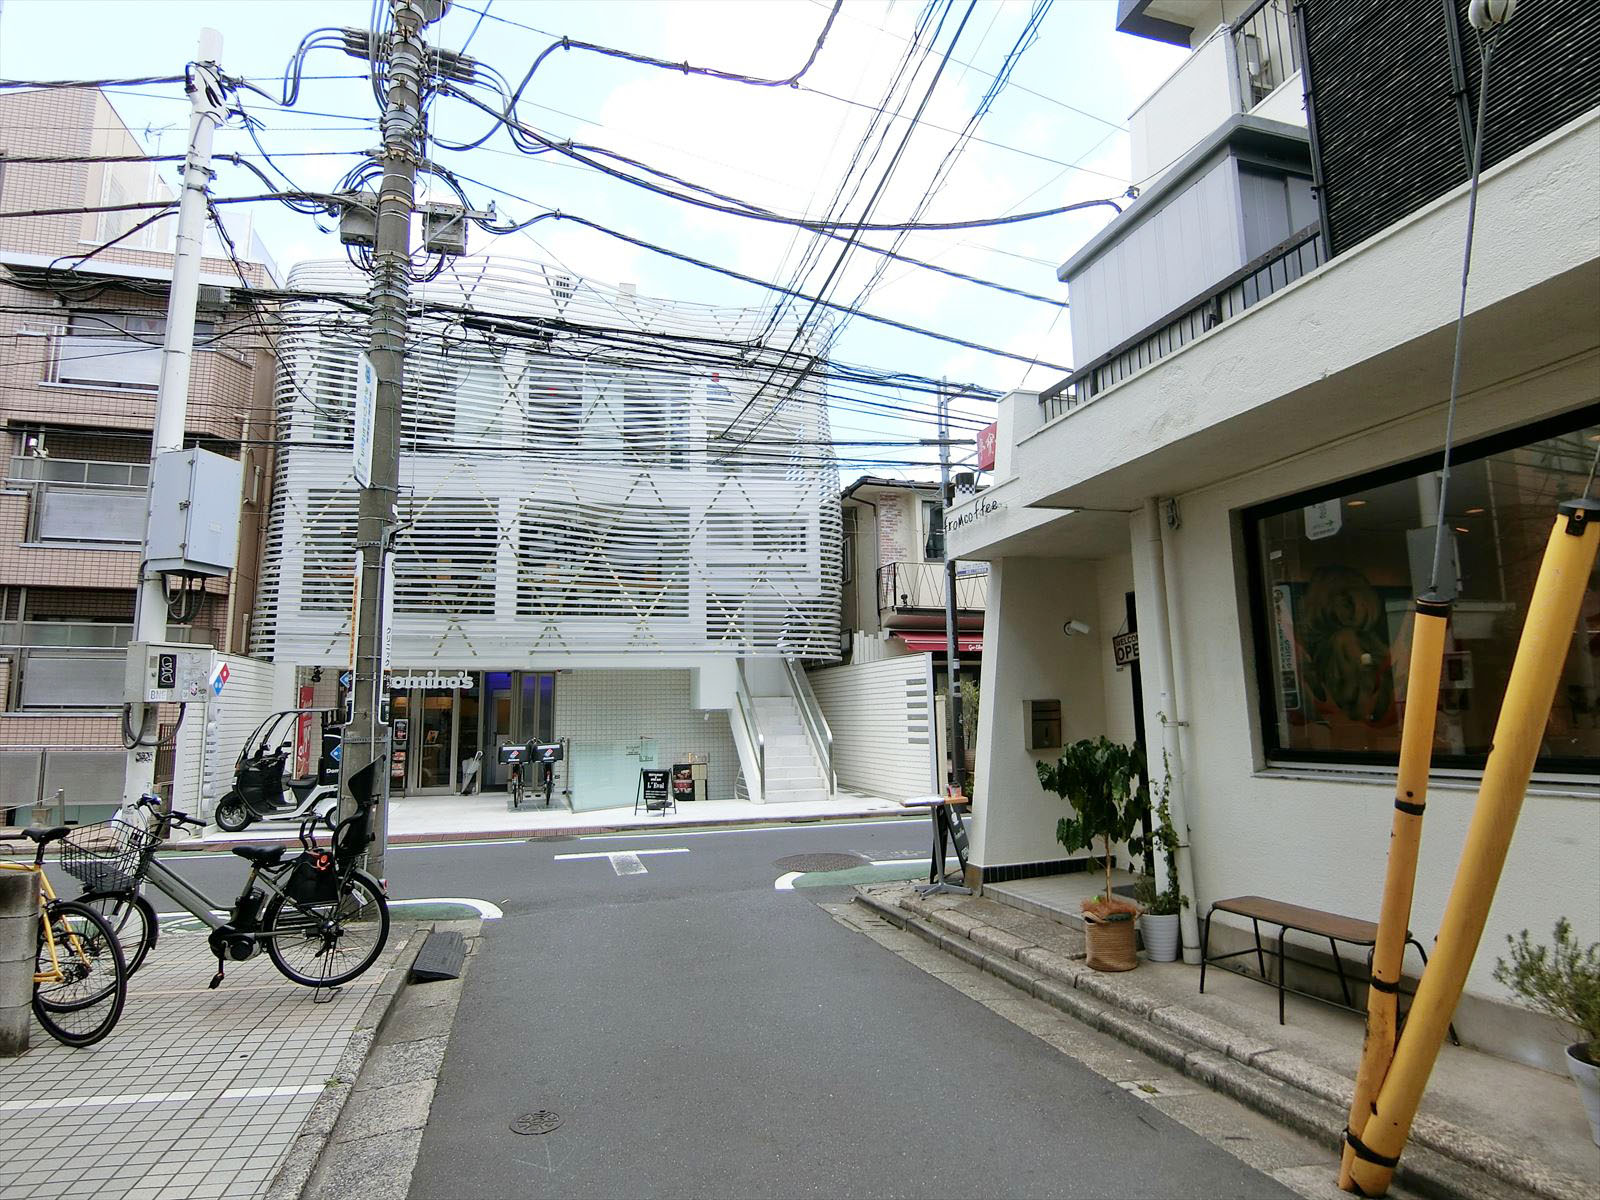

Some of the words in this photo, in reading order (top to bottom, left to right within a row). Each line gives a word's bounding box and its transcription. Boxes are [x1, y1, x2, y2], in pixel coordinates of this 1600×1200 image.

[1115, 634, 1137, 647] WELCO
[1117, 642, 1139, 661] OPE
[391, 671, 474, 689] omino's
